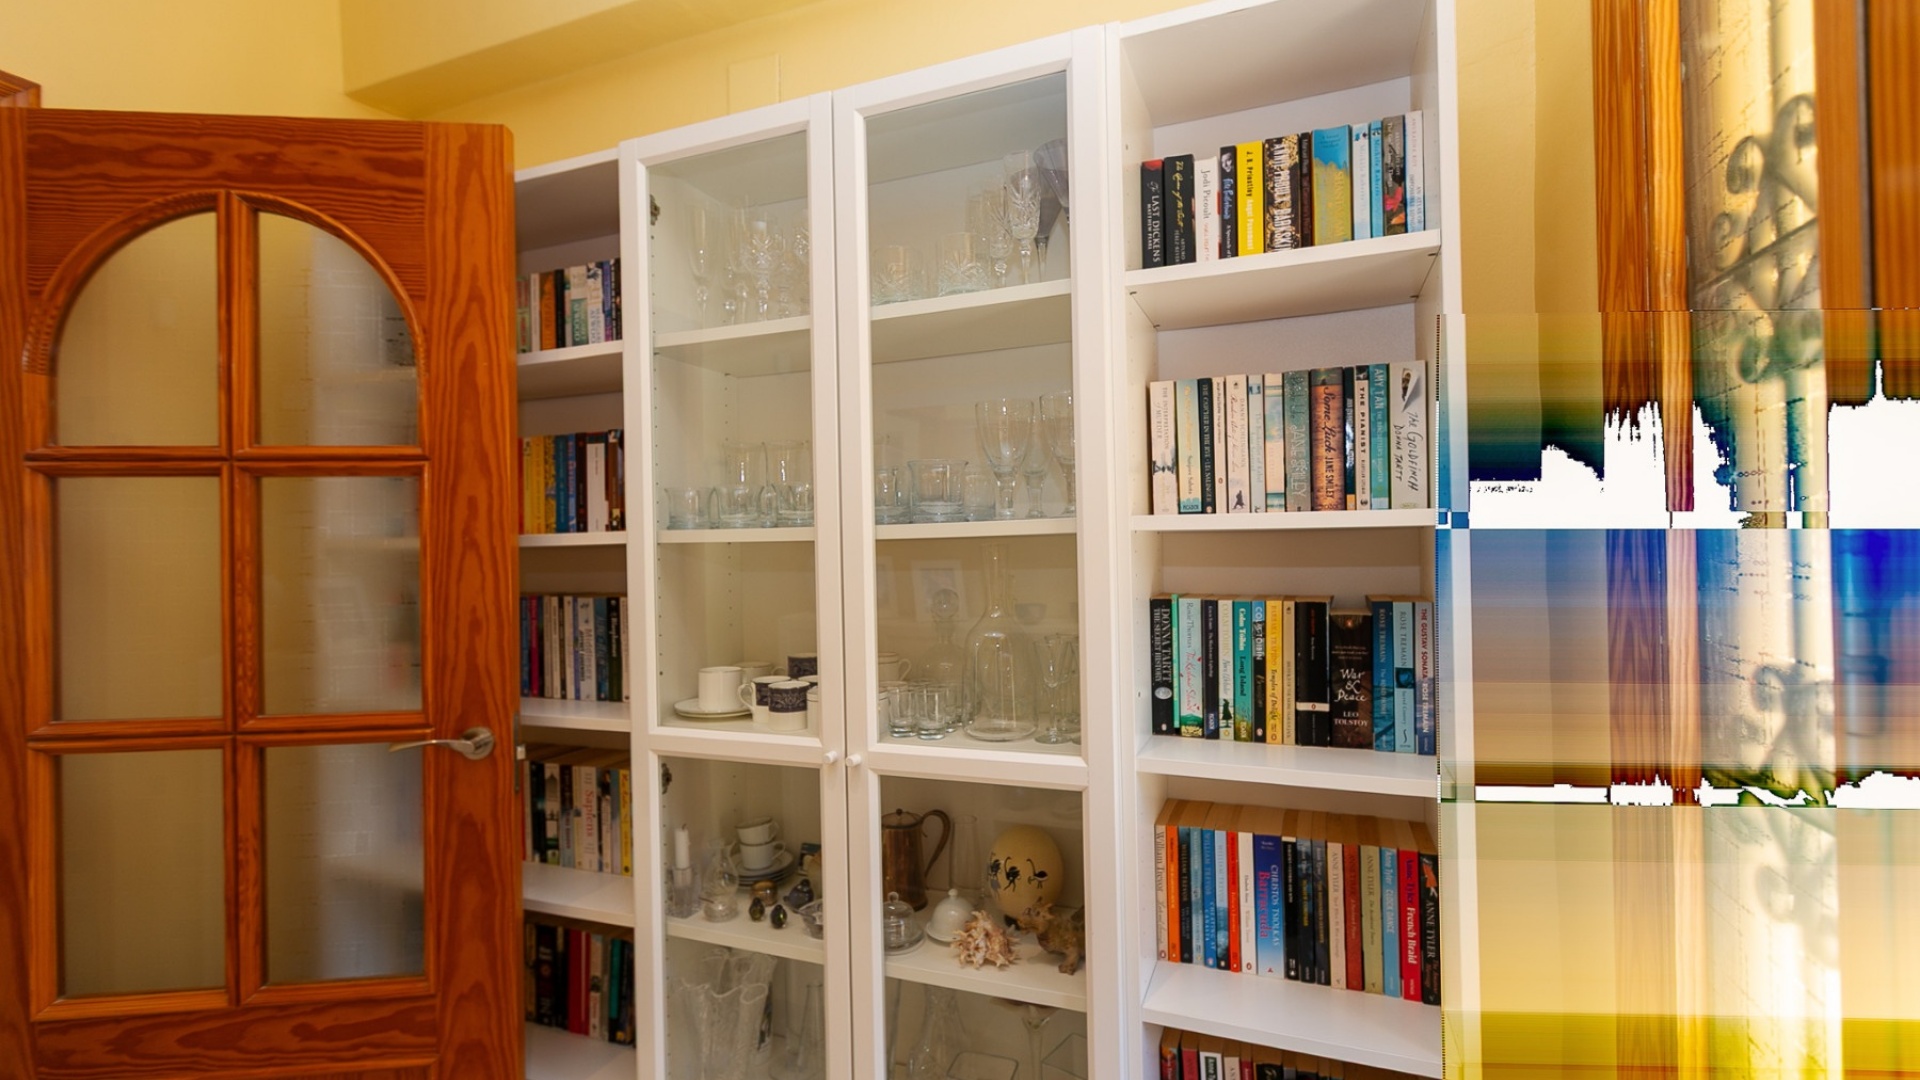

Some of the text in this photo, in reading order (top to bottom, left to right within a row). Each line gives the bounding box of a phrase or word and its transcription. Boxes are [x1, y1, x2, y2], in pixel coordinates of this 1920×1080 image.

[1201, 170, 1211, 219] Jodi Picoult
[1246, 167, 1255, 197] Priestley
[1274, 170, 1291, 203] PROULX
[1152, 195, 1161, 262] LAST DICKENS
[1374, 368, 1384, 386] AMY
[1324, 387, 1336, 421] Some
[1374, 390, 1384, 409] TAN
[1322, 422, 1336, 453] Luck
[1290, 425, 1307, 497] JANE SMILEY
[1325, 456, 1334, 473] JANE
[1393, 425, 1405, 482] DONNA TARTT
[1186, 602, 1194, 620] Rosie
[1399, 611, 1407, 630] ROSE
[1161, 608, 1171, 683] DONNA TARTT
[1186, 621, 1194, 649] Thomas
[1400, 633, 1408, 667] TREMAIN
[1154, 652, 1162, 682] HISTORY
[1238, 656, 1247, 674] Long
[1340, 668, 1365, 679] War
[1239, 676, 1247, 696] Island
[1334, 689, 1367, 702] Peace
[1345, 680, 1361, 694] &
[1334, 718, 1368, 727] TOLSTOY
[582, 790, 595, 837] Sapiens
[1156, 831, 1165, 892] William Trevor
[1385, 869, 1393, 884] Tyler
[1258, 871, 1272, 938] Barracuda
[1271, 864, 1280, 946] CHRISTOS TSIOLKAS
[1405, 882, 1414, 904] Tyler
[1407, 907, 1416, 938] French
[1426, 900, 1436, 958] ANNE TYLER
[1210, 941, 1216, 951] AT
[1408, 940, 1417, 964] Braid
[1207, 1058, 1215, 1073] Anne
